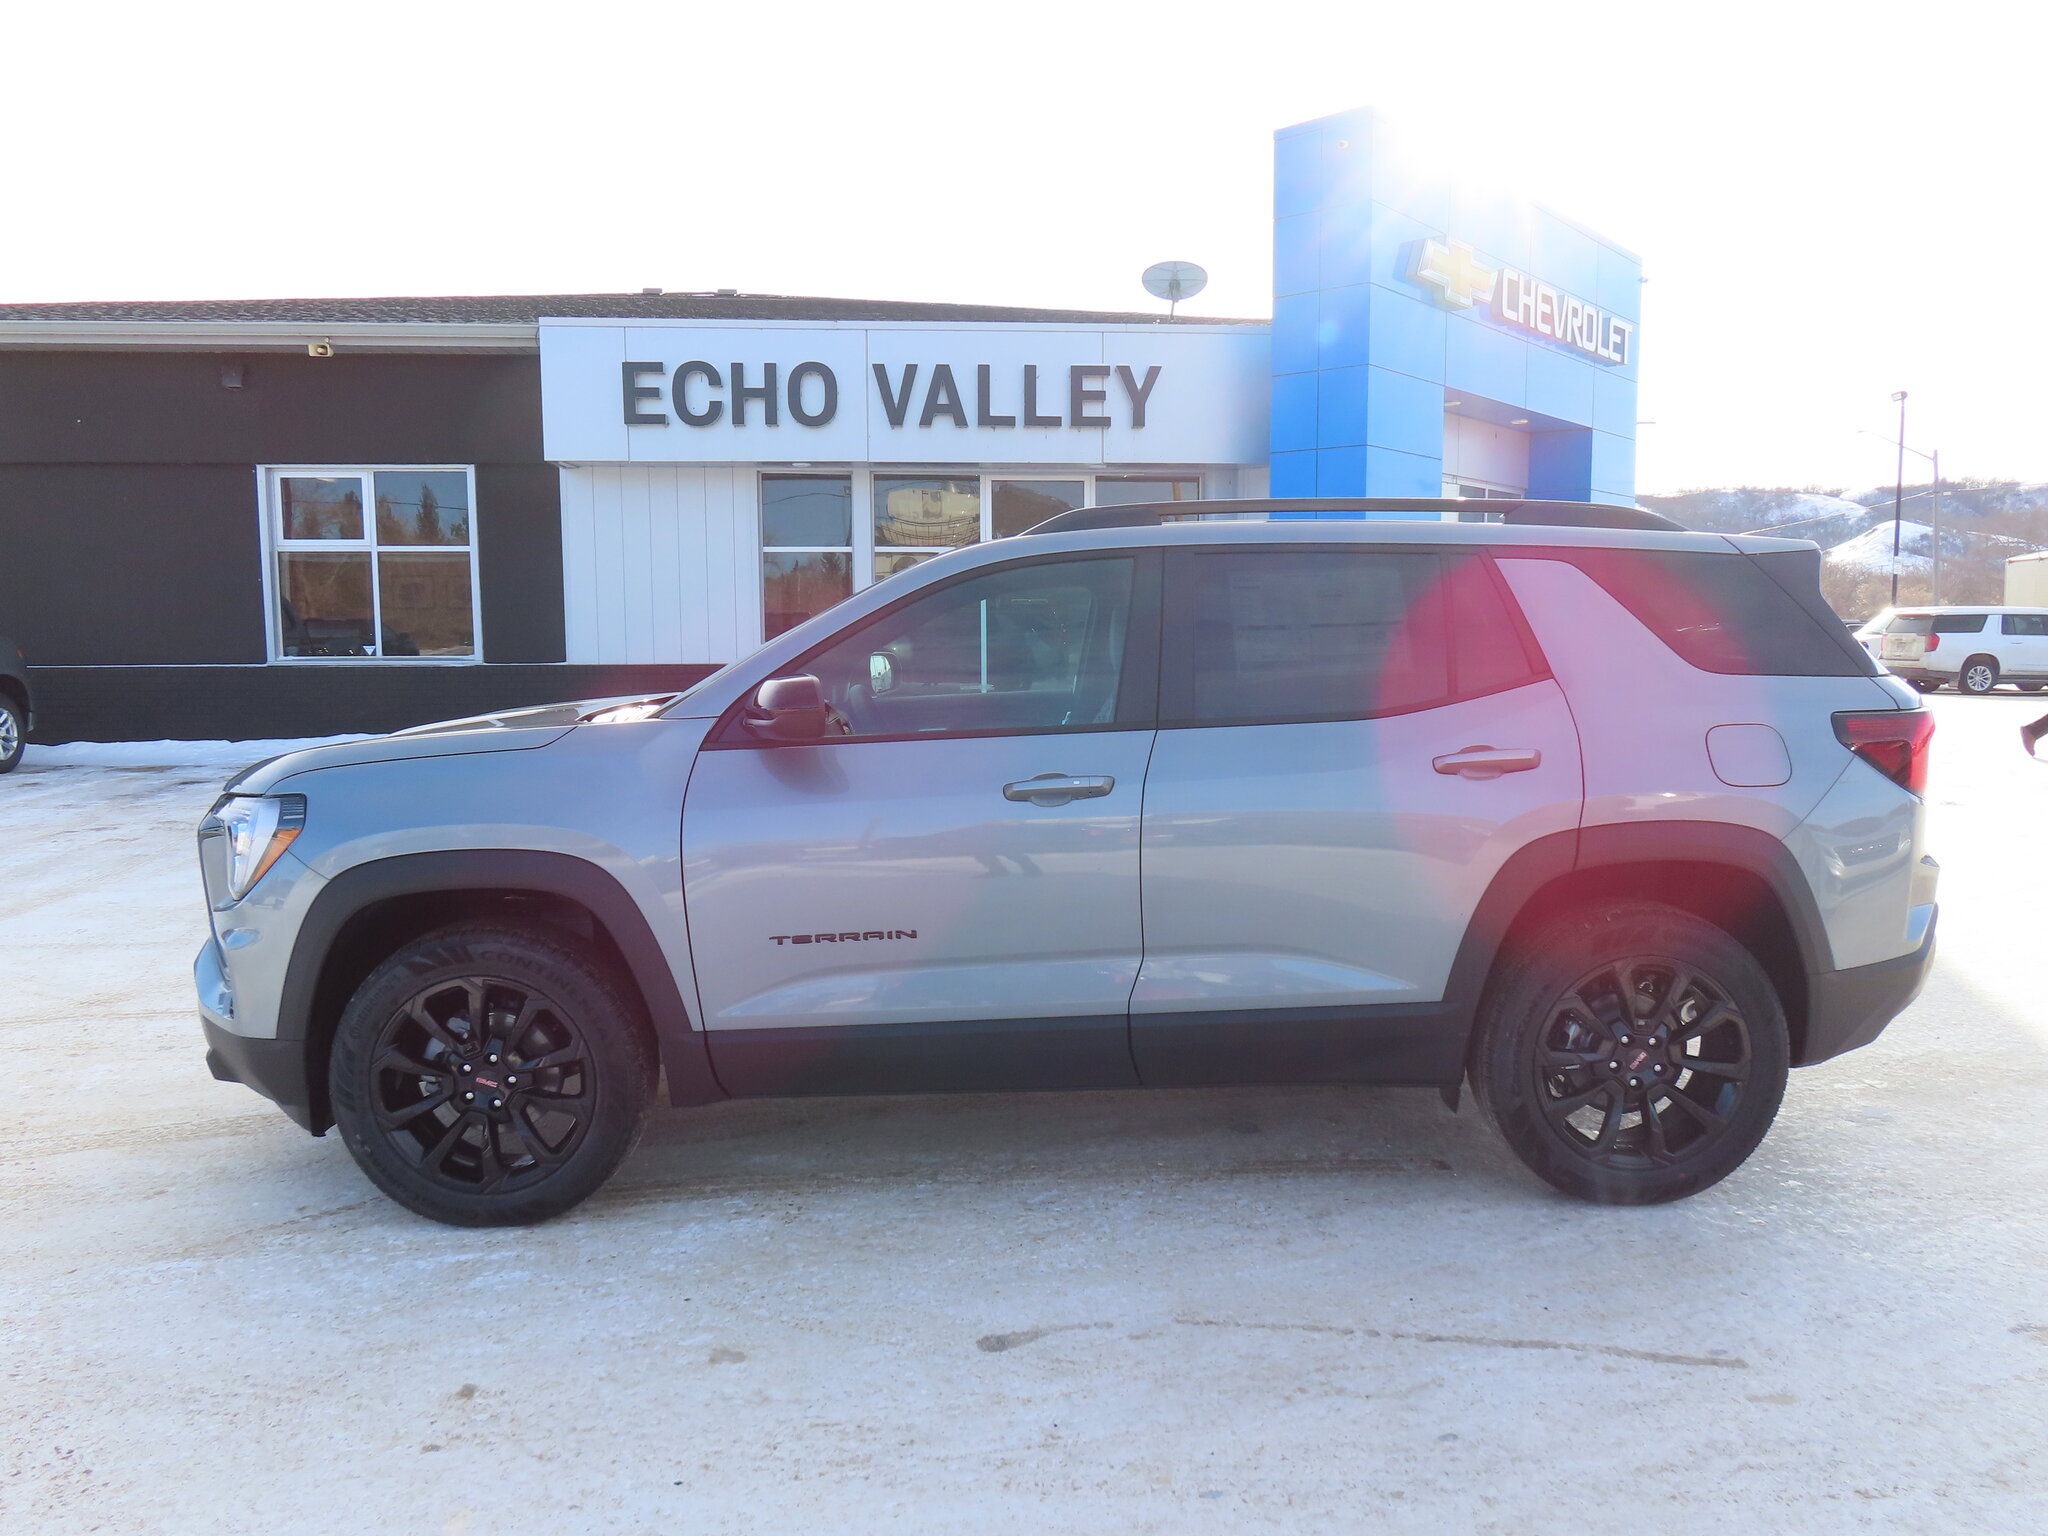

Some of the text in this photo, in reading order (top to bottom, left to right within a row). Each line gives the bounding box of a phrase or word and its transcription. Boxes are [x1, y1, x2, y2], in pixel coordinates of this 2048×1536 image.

[1502, 267, 1632, 365] CHEVROLET
[622, 360, 1162, 428] ECHO VALLEY
[768, 929, 918, 945] TERRAIN
[475, 1077, 498, 1088] GMC
